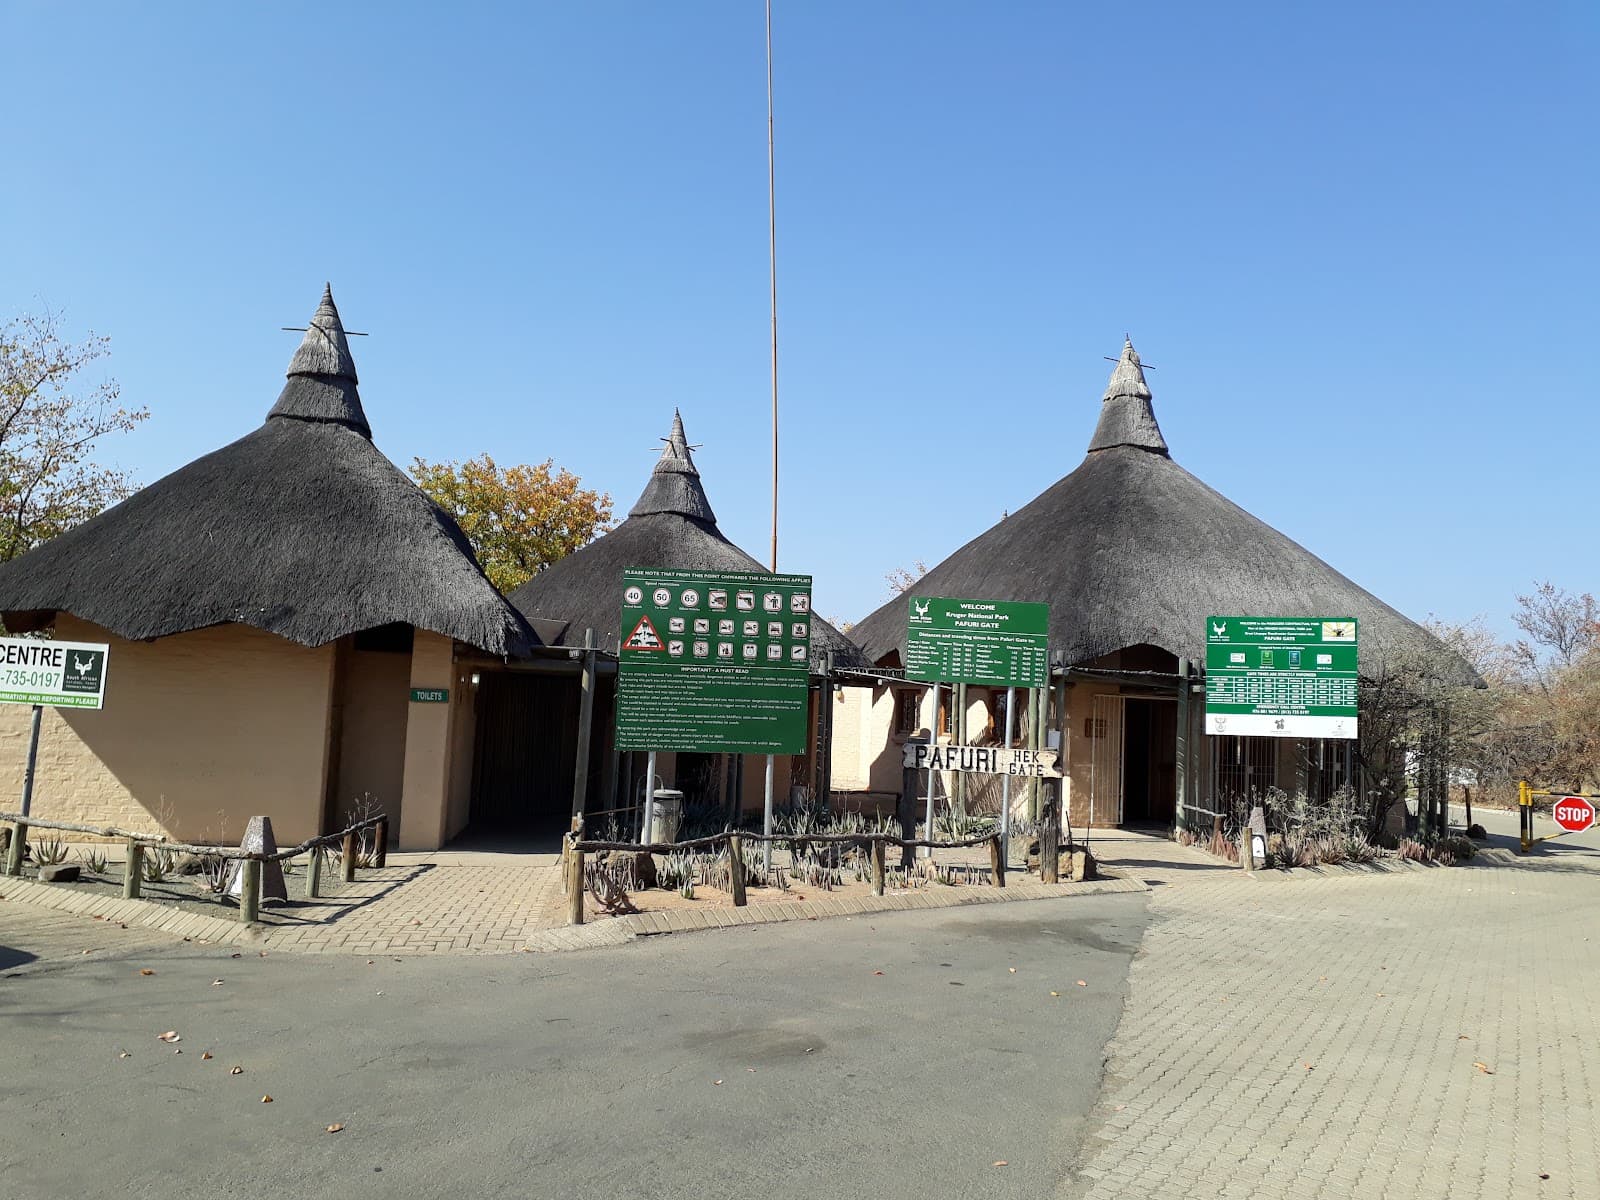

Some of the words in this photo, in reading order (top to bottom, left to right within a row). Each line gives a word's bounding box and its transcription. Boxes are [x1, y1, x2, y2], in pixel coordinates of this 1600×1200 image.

[656, 593, 667, 601] 50
[684, 594, 695, 602] 65
[960, 603, 995, 611] WELCOME
[945, 611, 967, 619] Kruger
[42, 695, 75, 704] REPORTING
[76, 697, 98, 706] PLEASE
[417, 691, 442, 701] TOILETS
[915, 745, 997, 773] PAFURI
[1014, 750, 1040, 764] HEK
[1009, 763, 1044, 777] GATE
[1558, 807, 1590, 822] STOP
